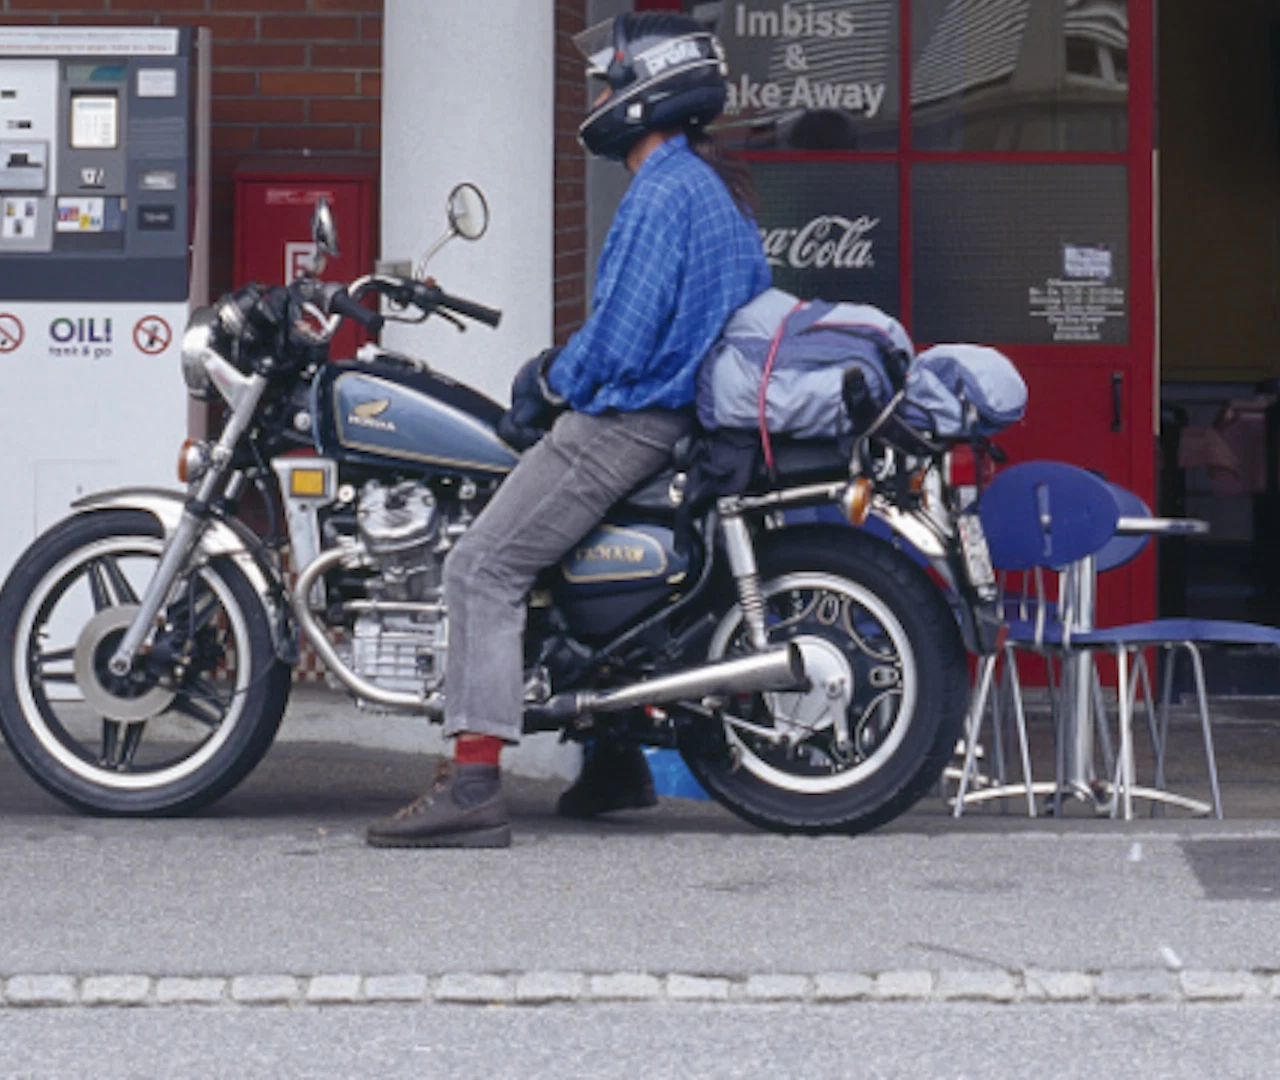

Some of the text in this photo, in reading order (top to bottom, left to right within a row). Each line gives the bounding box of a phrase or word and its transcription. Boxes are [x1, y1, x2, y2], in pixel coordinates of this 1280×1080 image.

[735, 3, 855, 37] Imbiss
[784, 43, 808, 71] &
[724, 74, 886, 119] ake Away
[49, 316, 112, 343] OIL!
[93, 347, 113, 361] go
[347, 414, 397, 432] HONDA
